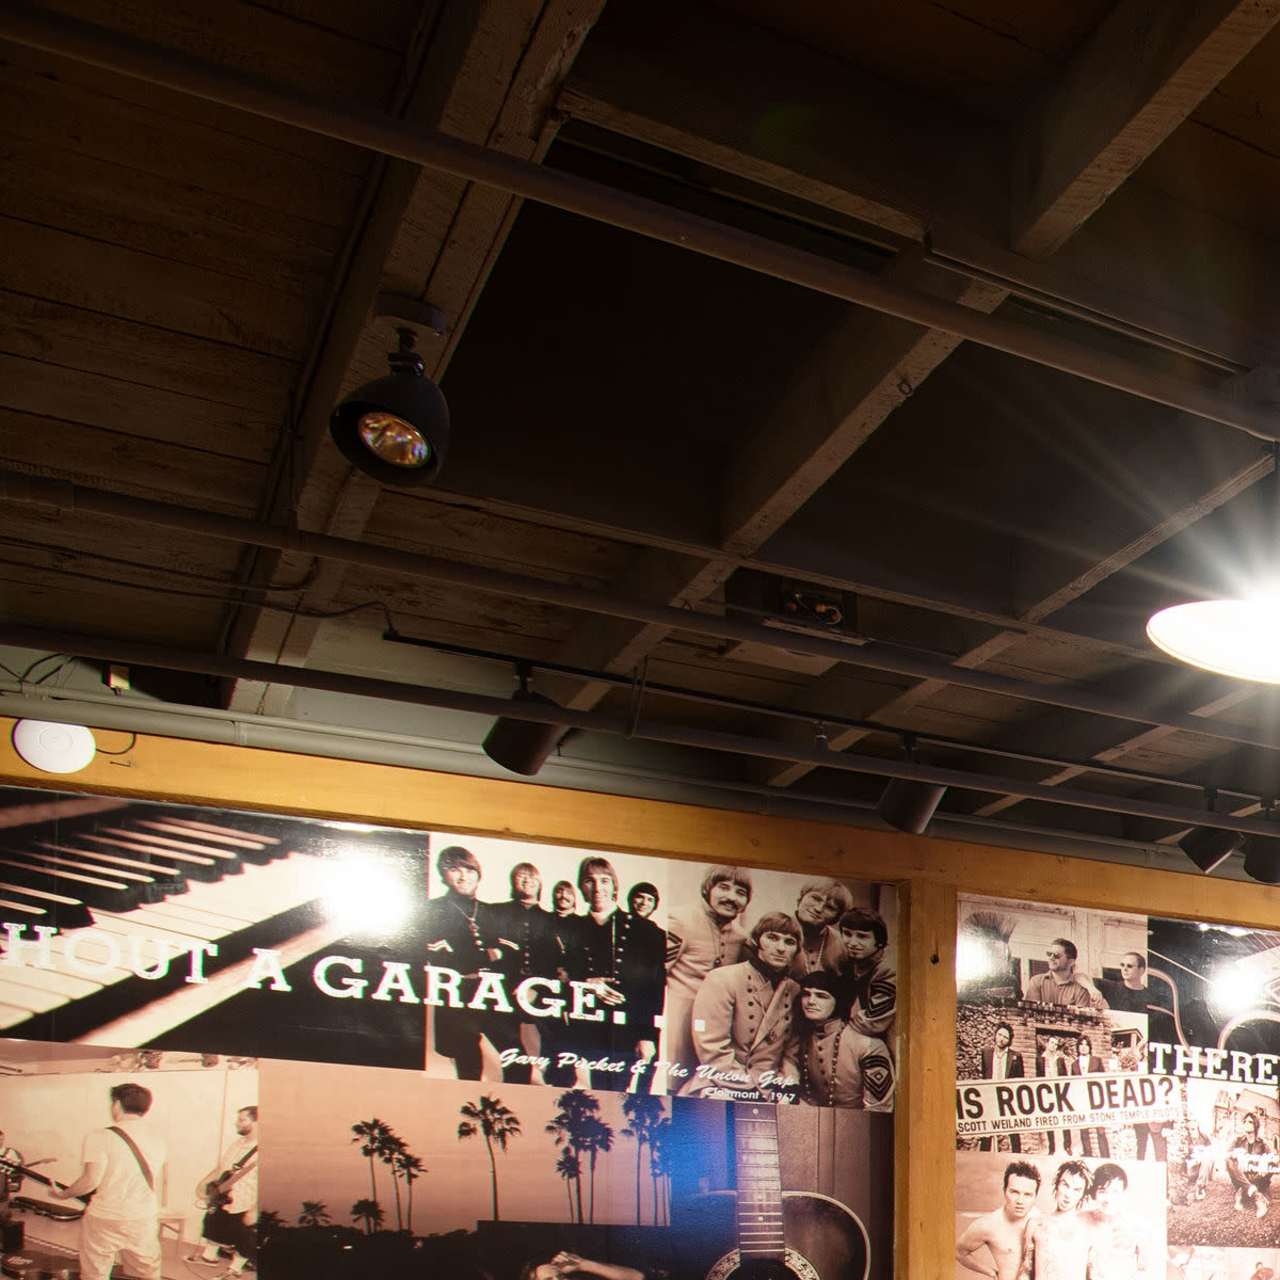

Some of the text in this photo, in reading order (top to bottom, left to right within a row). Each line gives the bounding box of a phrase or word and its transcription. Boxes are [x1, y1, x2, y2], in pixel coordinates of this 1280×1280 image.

[250, 947, 292, 992] A
[500, 1048, 551, 1069] Gary
[630, 1057, 646, 1074] &
[696, 1065, 751, 1083] Union
[758, 1070, 799, 1088] Gap
[1149, 1042, 1279, 1085] THERE
[957, 1077, 1173, 1120] IS ROCK DEAD?
[958, 1120, 987, 1133] SCOTT
[992, 1118, 1031, 1130] WEILAND
[1036, 1115, 1059, 1127] FIRED
[1063, 1113, 1086, 1125] FROM
[1089, 1111, 1116, 1122] STONE
